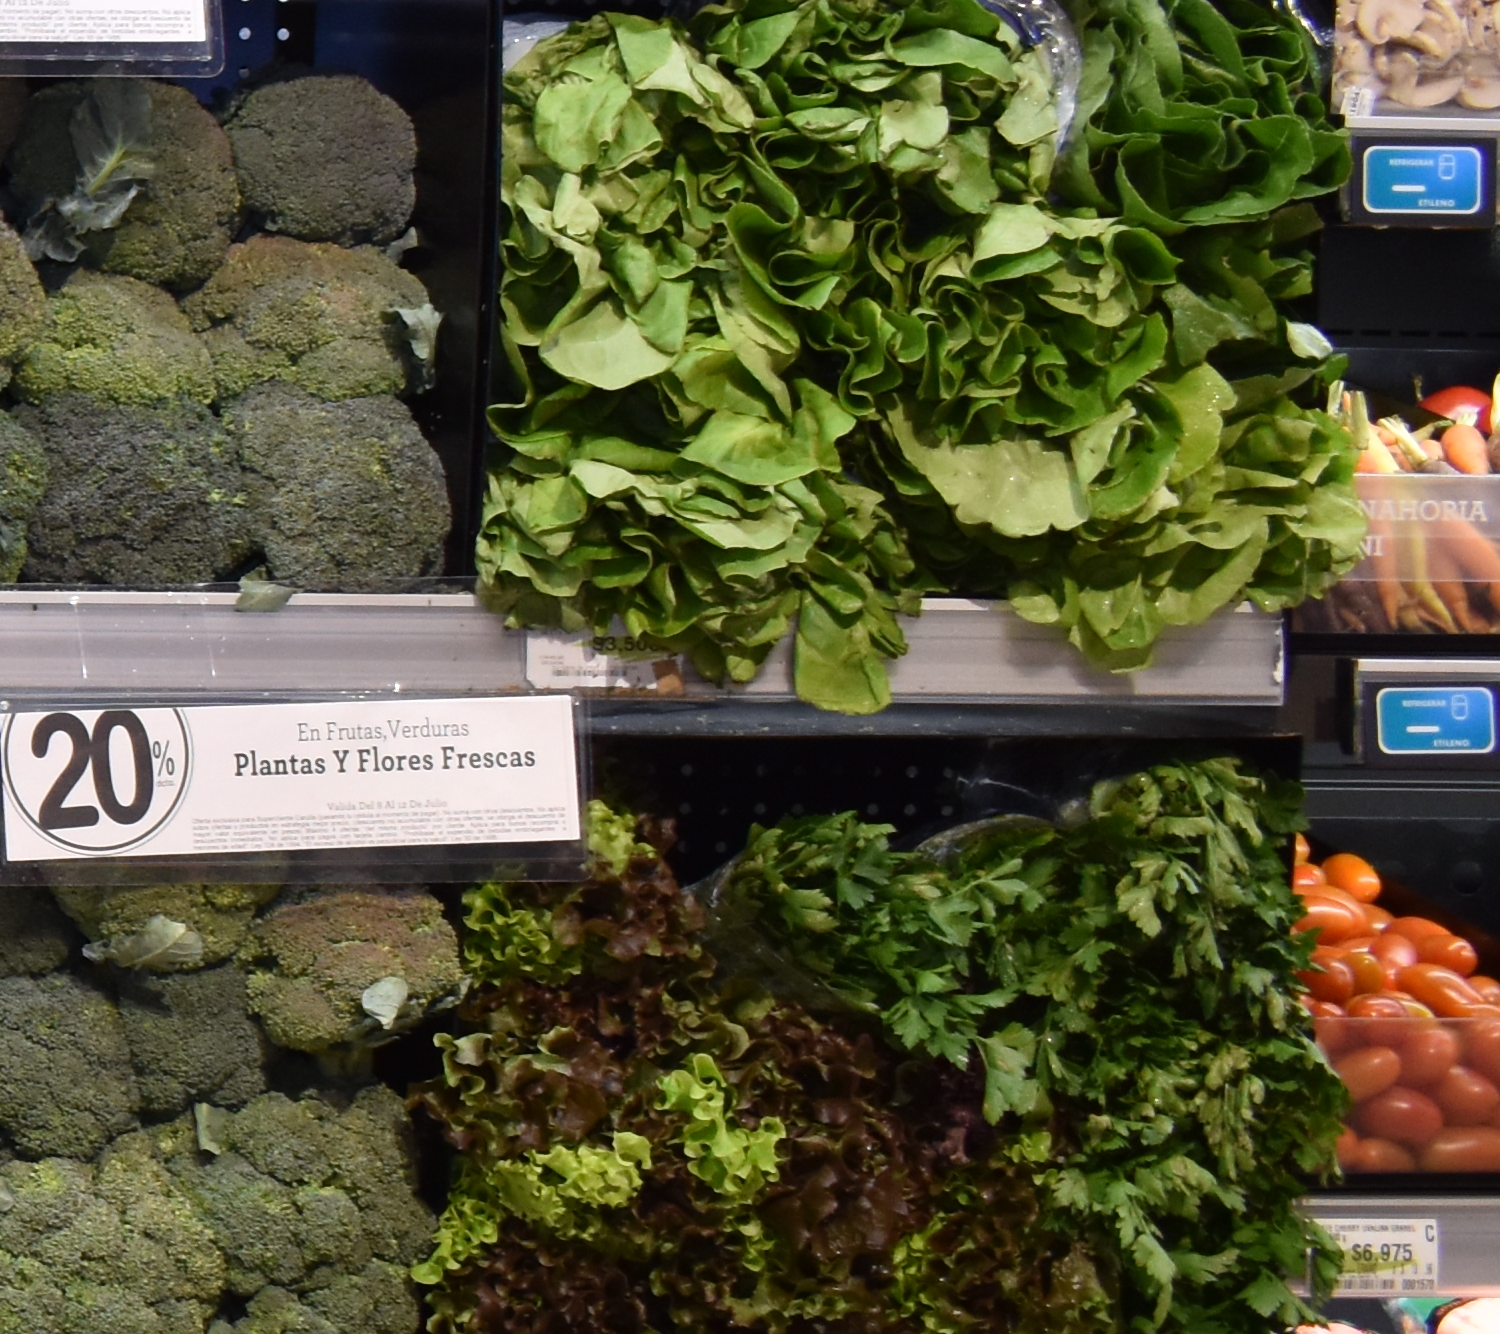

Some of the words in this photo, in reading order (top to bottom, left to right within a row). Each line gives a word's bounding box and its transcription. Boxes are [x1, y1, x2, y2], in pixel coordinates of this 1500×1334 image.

[297, 723, 320, 741] En
[234, 752, 326, 777] Plantas
[334, 750, 350, 773] Y
[356, 747, 433, 772] Flores
[442, 746, 536, 770] Frescas
[359, 802, 374, 811] Del
[409, 800, 423, 810] De
[1425, 1225, 1434, 1242] C
[1352, 1244, 1412, 1262] $6,975
